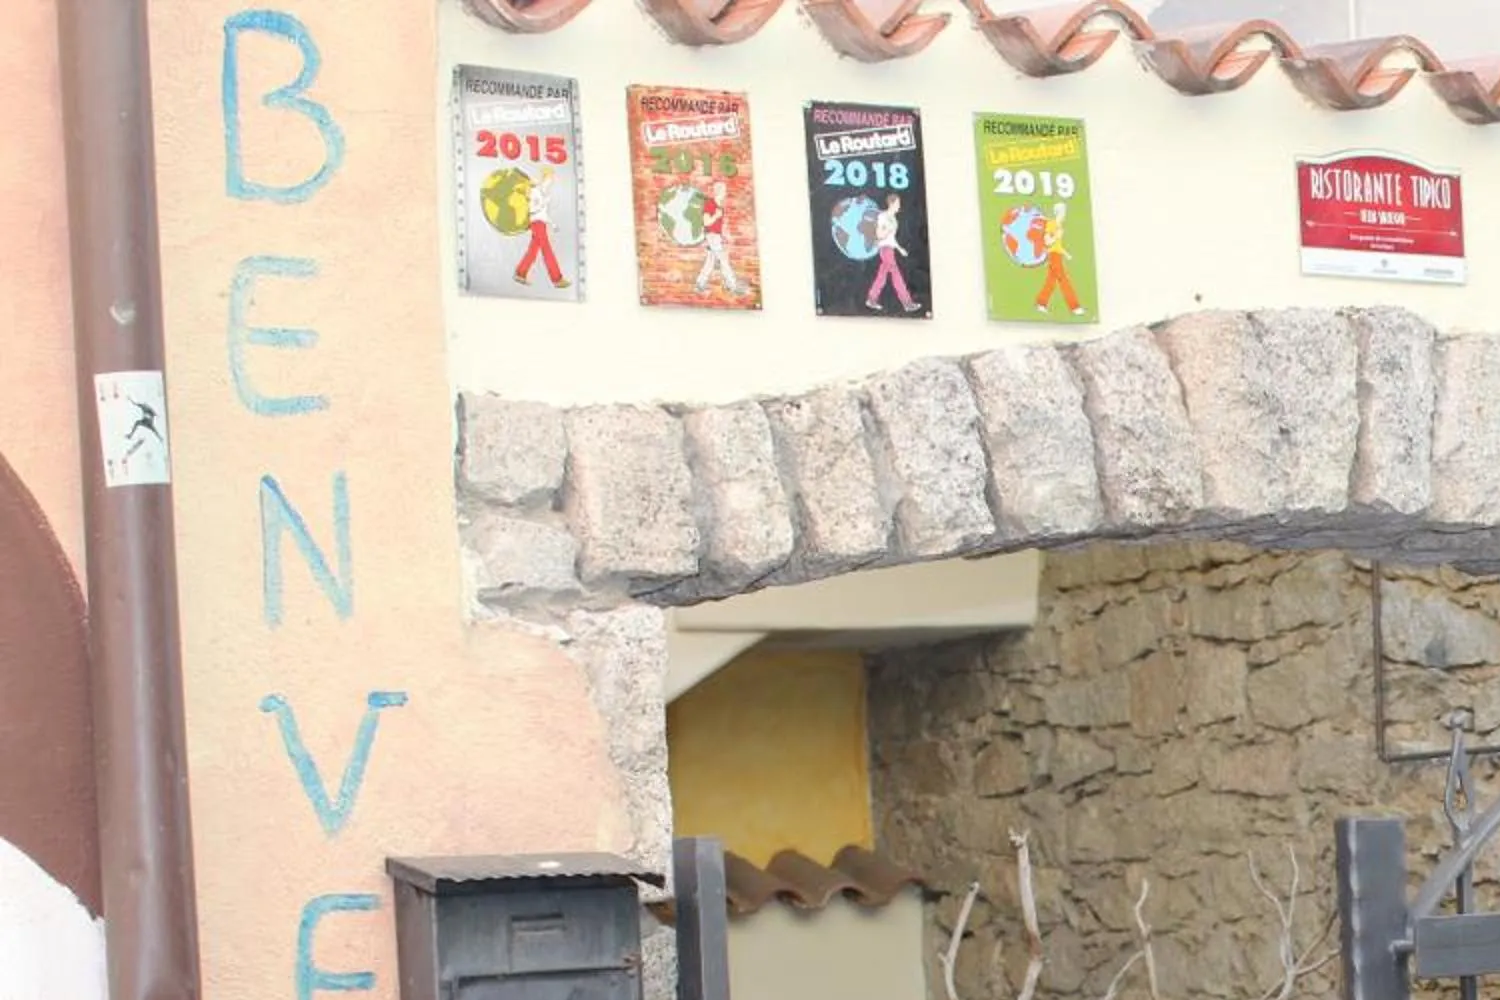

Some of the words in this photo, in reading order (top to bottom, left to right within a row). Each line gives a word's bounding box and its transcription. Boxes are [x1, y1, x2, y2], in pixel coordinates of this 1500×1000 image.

[668, 114, 737, 139] Routard
[819, 138, 840, 155] Le
[840, 127, 911, 152] Routard
[475, 129, 568, 165] 2015
[649, 146, 739, 177] 2016
[823, 159, 910, 190] 2018
[992, 168, 1076, 199] 2019
[1310, 167, 1403, 206] RISTORANTE
[1409, 175, 1451, 209] TIPICO
